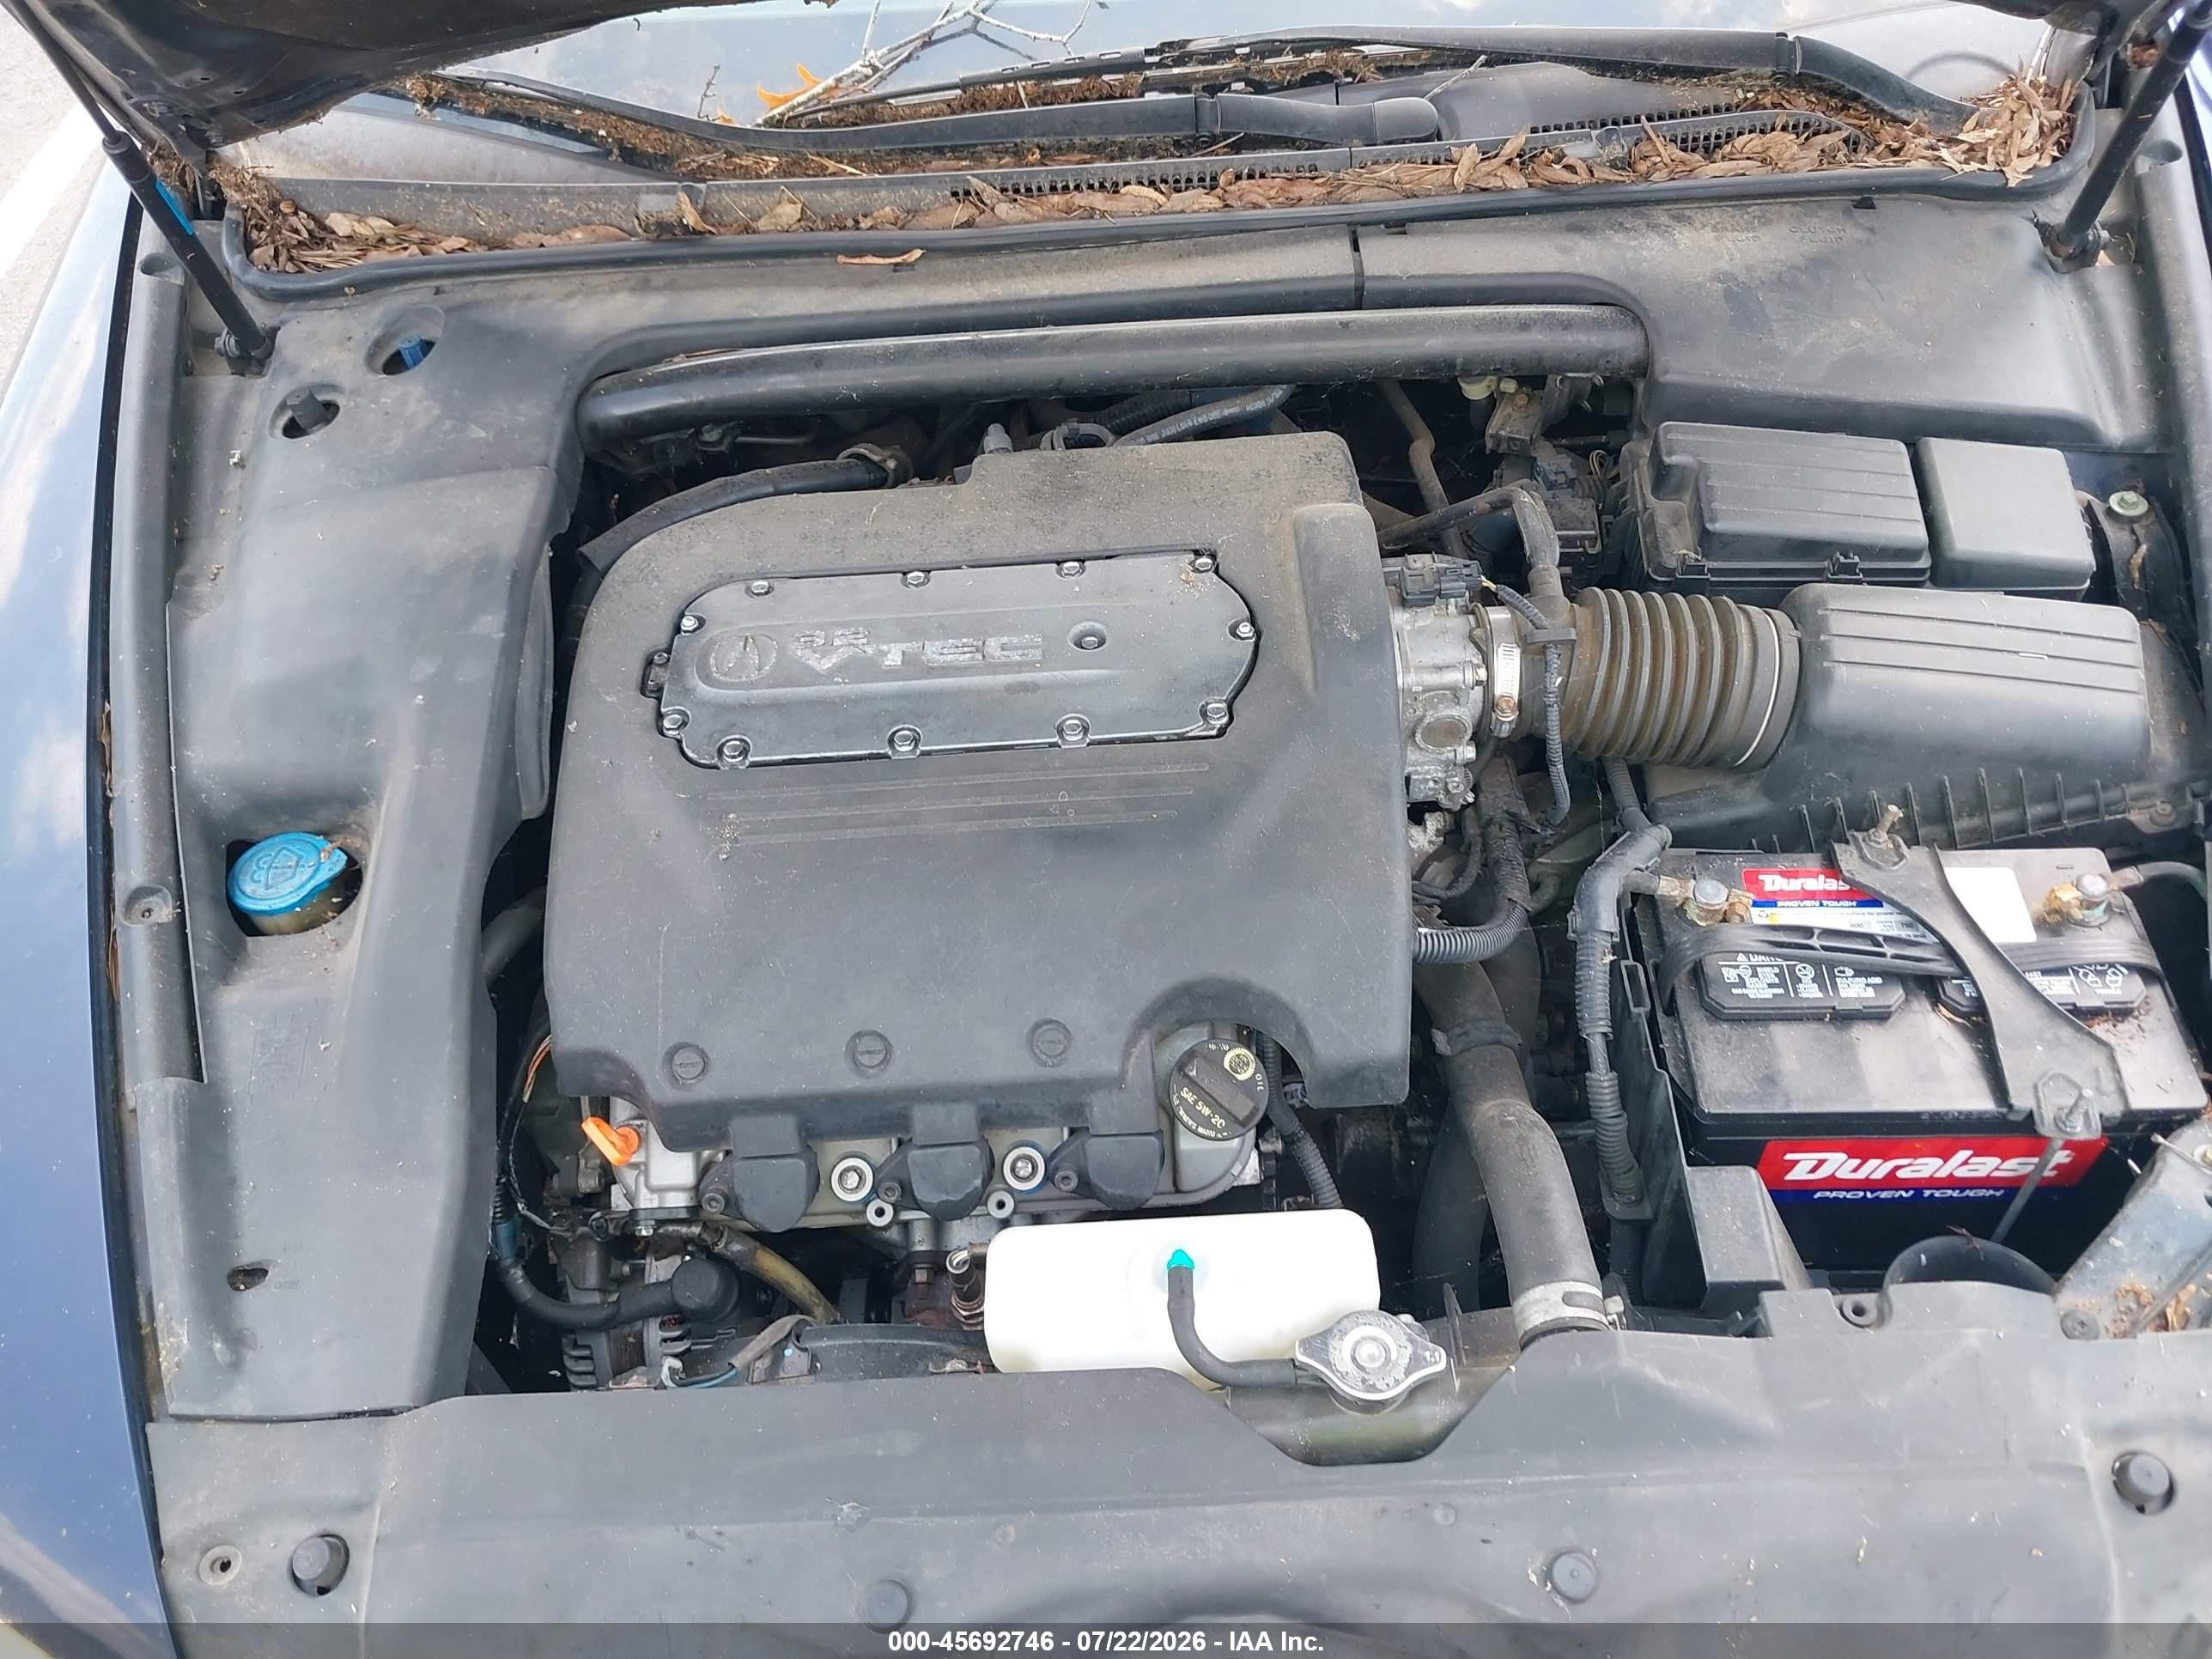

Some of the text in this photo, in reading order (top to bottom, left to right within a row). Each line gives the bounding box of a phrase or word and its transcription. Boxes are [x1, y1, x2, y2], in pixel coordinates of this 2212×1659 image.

[1710, 225, 1759, 234] BRAKE
[1789, 225, 1847, 234] CLUTCH
[1799, 235, 1844, 244] FLUID
[788, 633, 1044, 673] VTEC
[1758, 873, 1856, 892] Duralas
[1255, 1073, 1265, 1092] OIL
[1180, 1086, 1198, 1105] SAE
[1782, 1149, 2074, 1181] Duralast
[1813, 1188, 2005, 1200] PROVEN TOUGH
